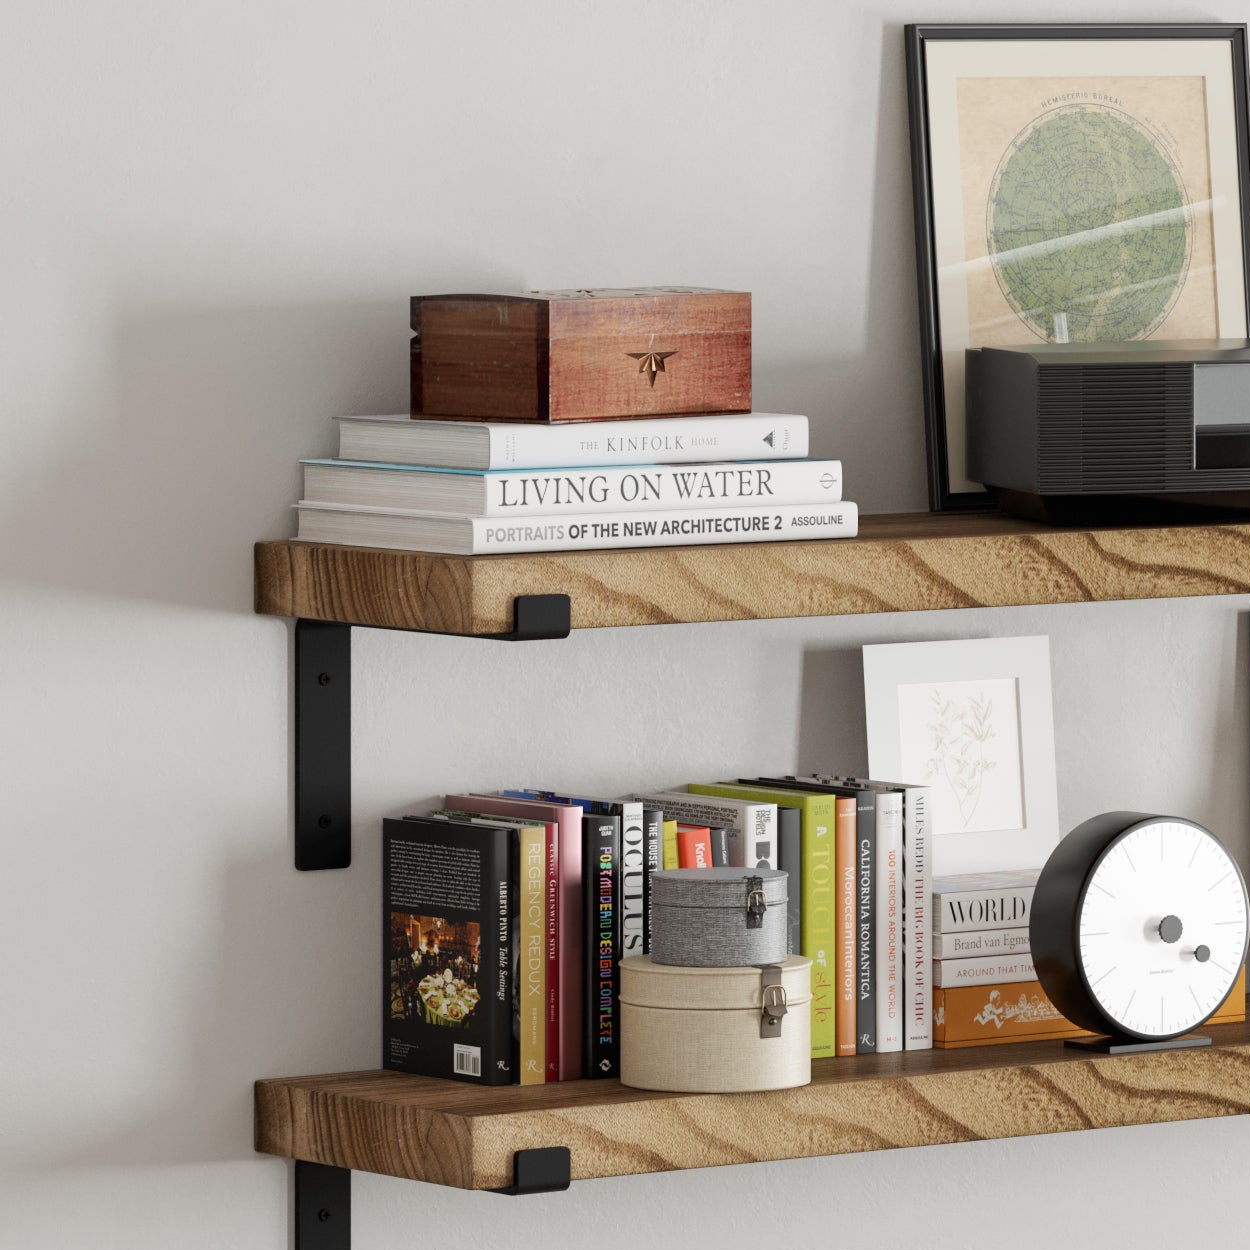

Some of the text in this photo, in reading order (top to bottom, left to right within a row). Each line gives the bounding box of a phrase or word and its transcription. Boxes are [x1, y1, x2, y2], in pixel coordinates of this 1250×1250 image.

[580, 435, 720, 453] THE KINFOLK HOME
[499, 469, 774, 507] LIVING ON WATER
[486, 515, 783, 543] PORTRAITS OF THE NEW ARCHITECTURE 2
[791, 514, 844, 527] ASSOULINE
[648, 822, 658, 837] THE
[816, 826, 828, 837] A
[648, 840, 658, 867] HOUSE
[549, 879, 557, 934] GREENWICH
[624, 825, 643, 951] OCULUS
[812, 844, 831, 945] TOUCH
[949, 896, 1026, 924] WORLD
[528, 843, 542, 996] REGENCY REDUX
[860, 839, 871, 1000] CALIFORNIA ROMANTICA
[915, 795, 924, 1026] MILES REDD THE BIG BOOK OF CHIC
[497, 881, 507, 1001] ALBERTO PINTO Table Settings
[600, 847, 612, 1044] POSTMODERN DESIGN COMPLETE
[887, 850, 896, 1019] 100 INTERIORS AROUND THE WORLD
[954, 934, 1030, 951] Brand van Egmo
[957, 964, 1036, 978] AROUND THAT TIM
[811, 972, 832, 1023] style
